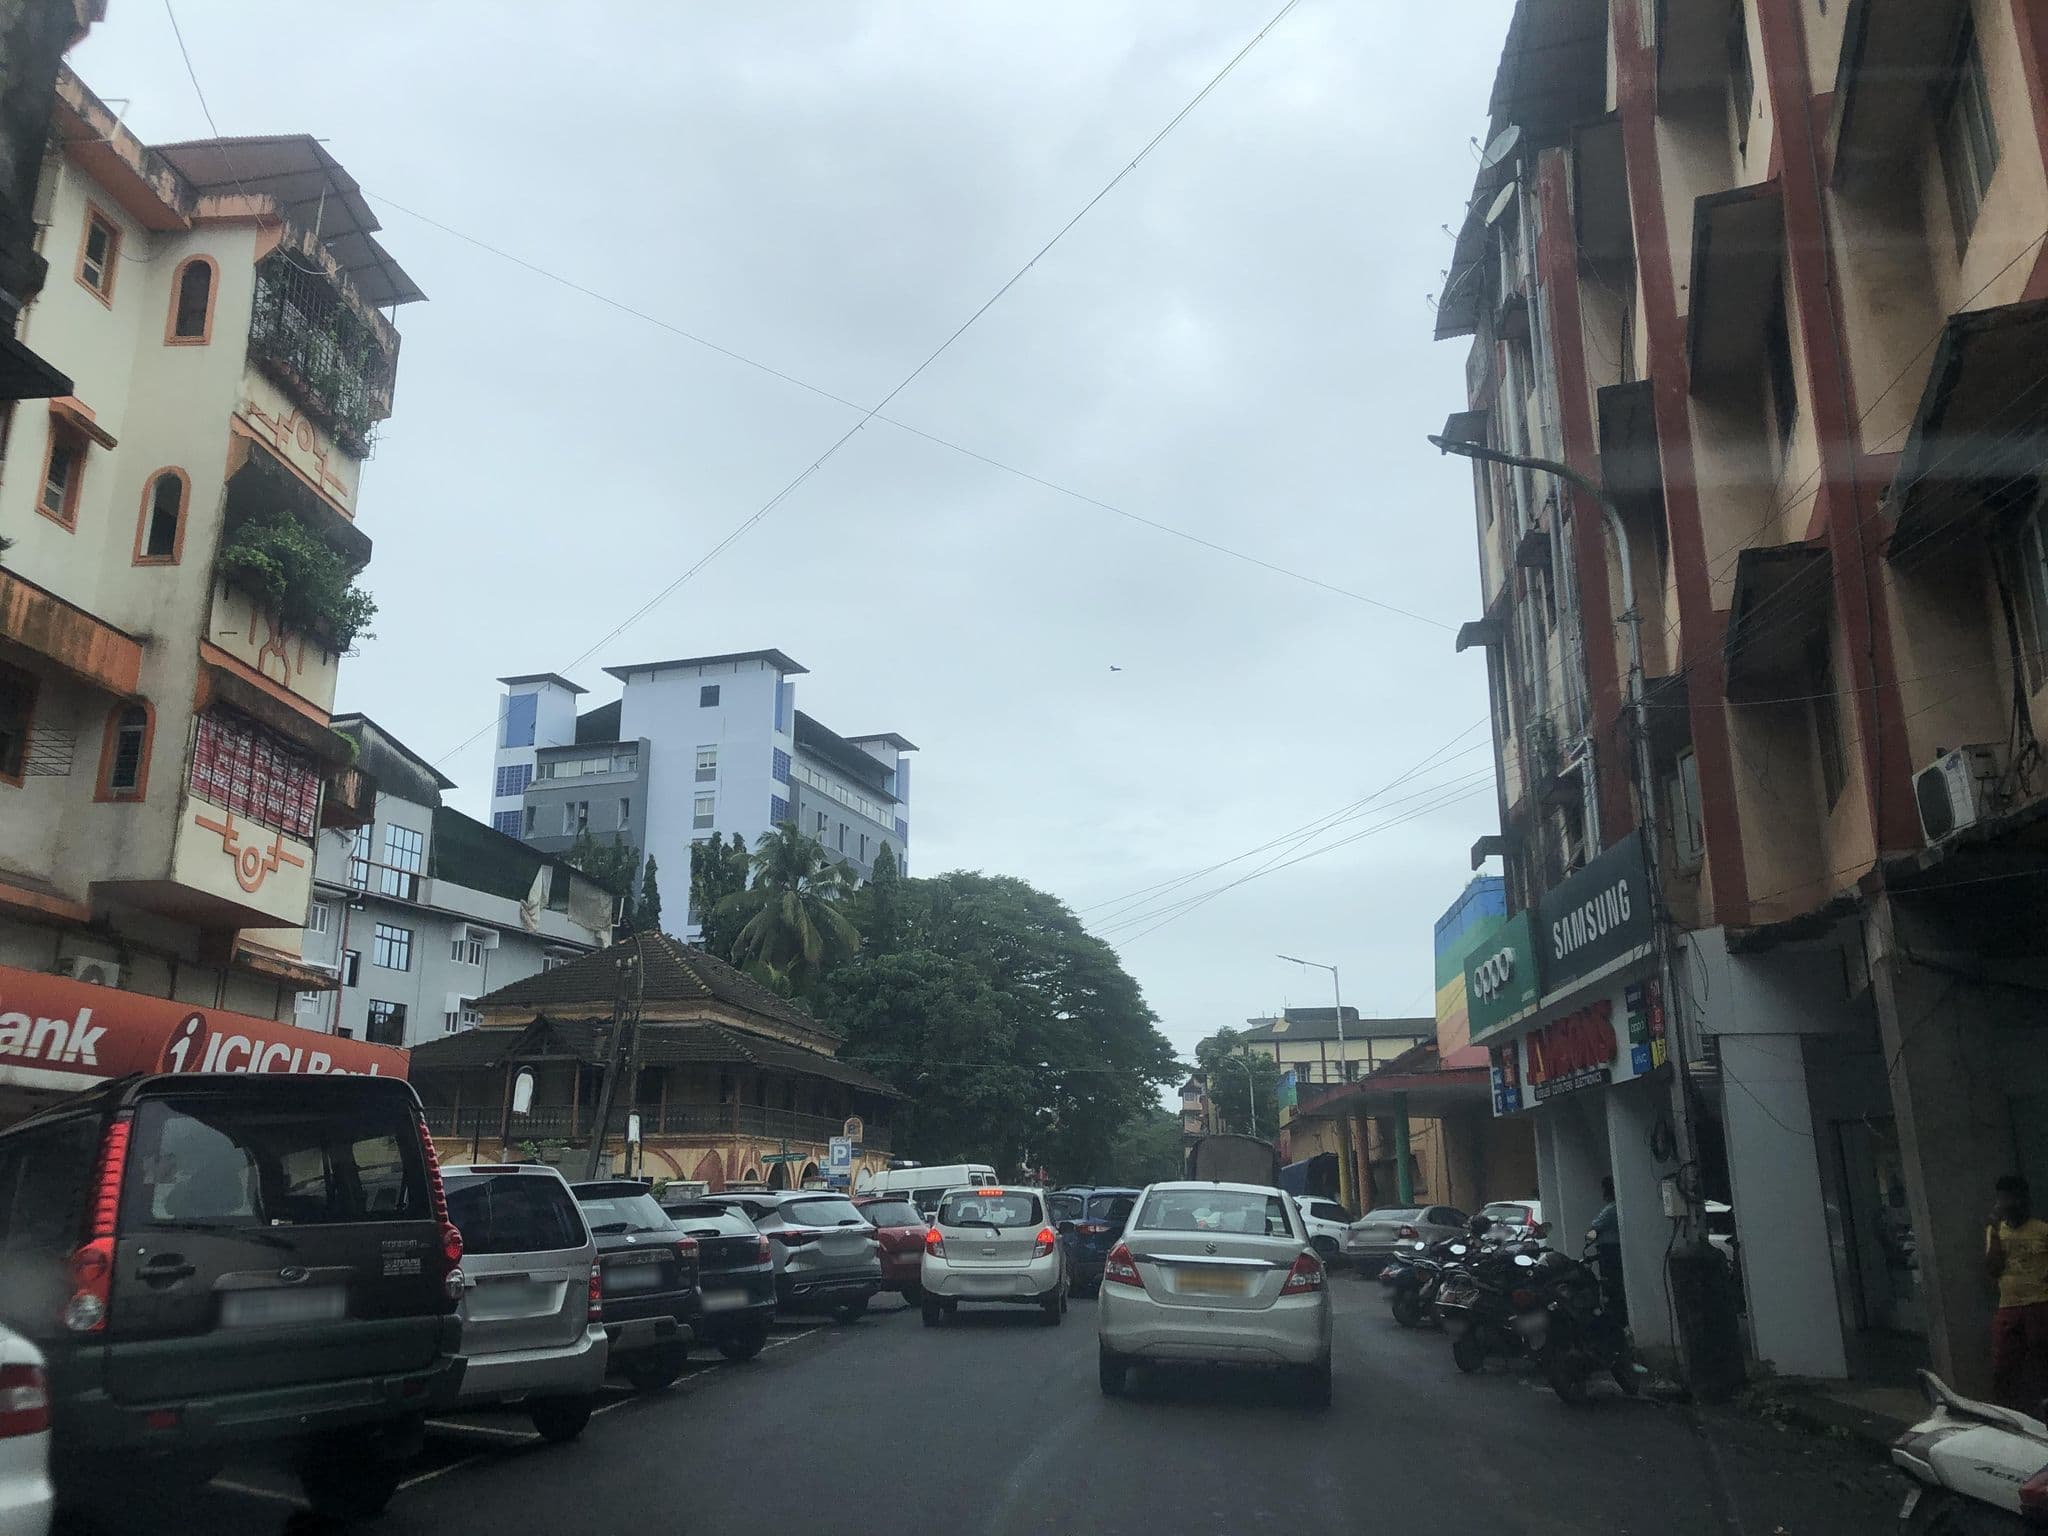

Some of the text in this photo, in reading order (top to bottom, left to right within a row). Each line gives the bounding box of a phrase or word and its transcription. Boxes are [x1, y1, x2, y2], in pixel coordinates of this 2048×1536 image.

[1553, 878, 1631, 960] SAMSUNG
[1474, 947, 1514, 1005] oppo
[0, 1007, 108, 1066] ank
[201, 1031, 304, 1074] ICICI
[833, 1145, 847, 1165] P
[1973, 1466, 2021, 1483] Acti
